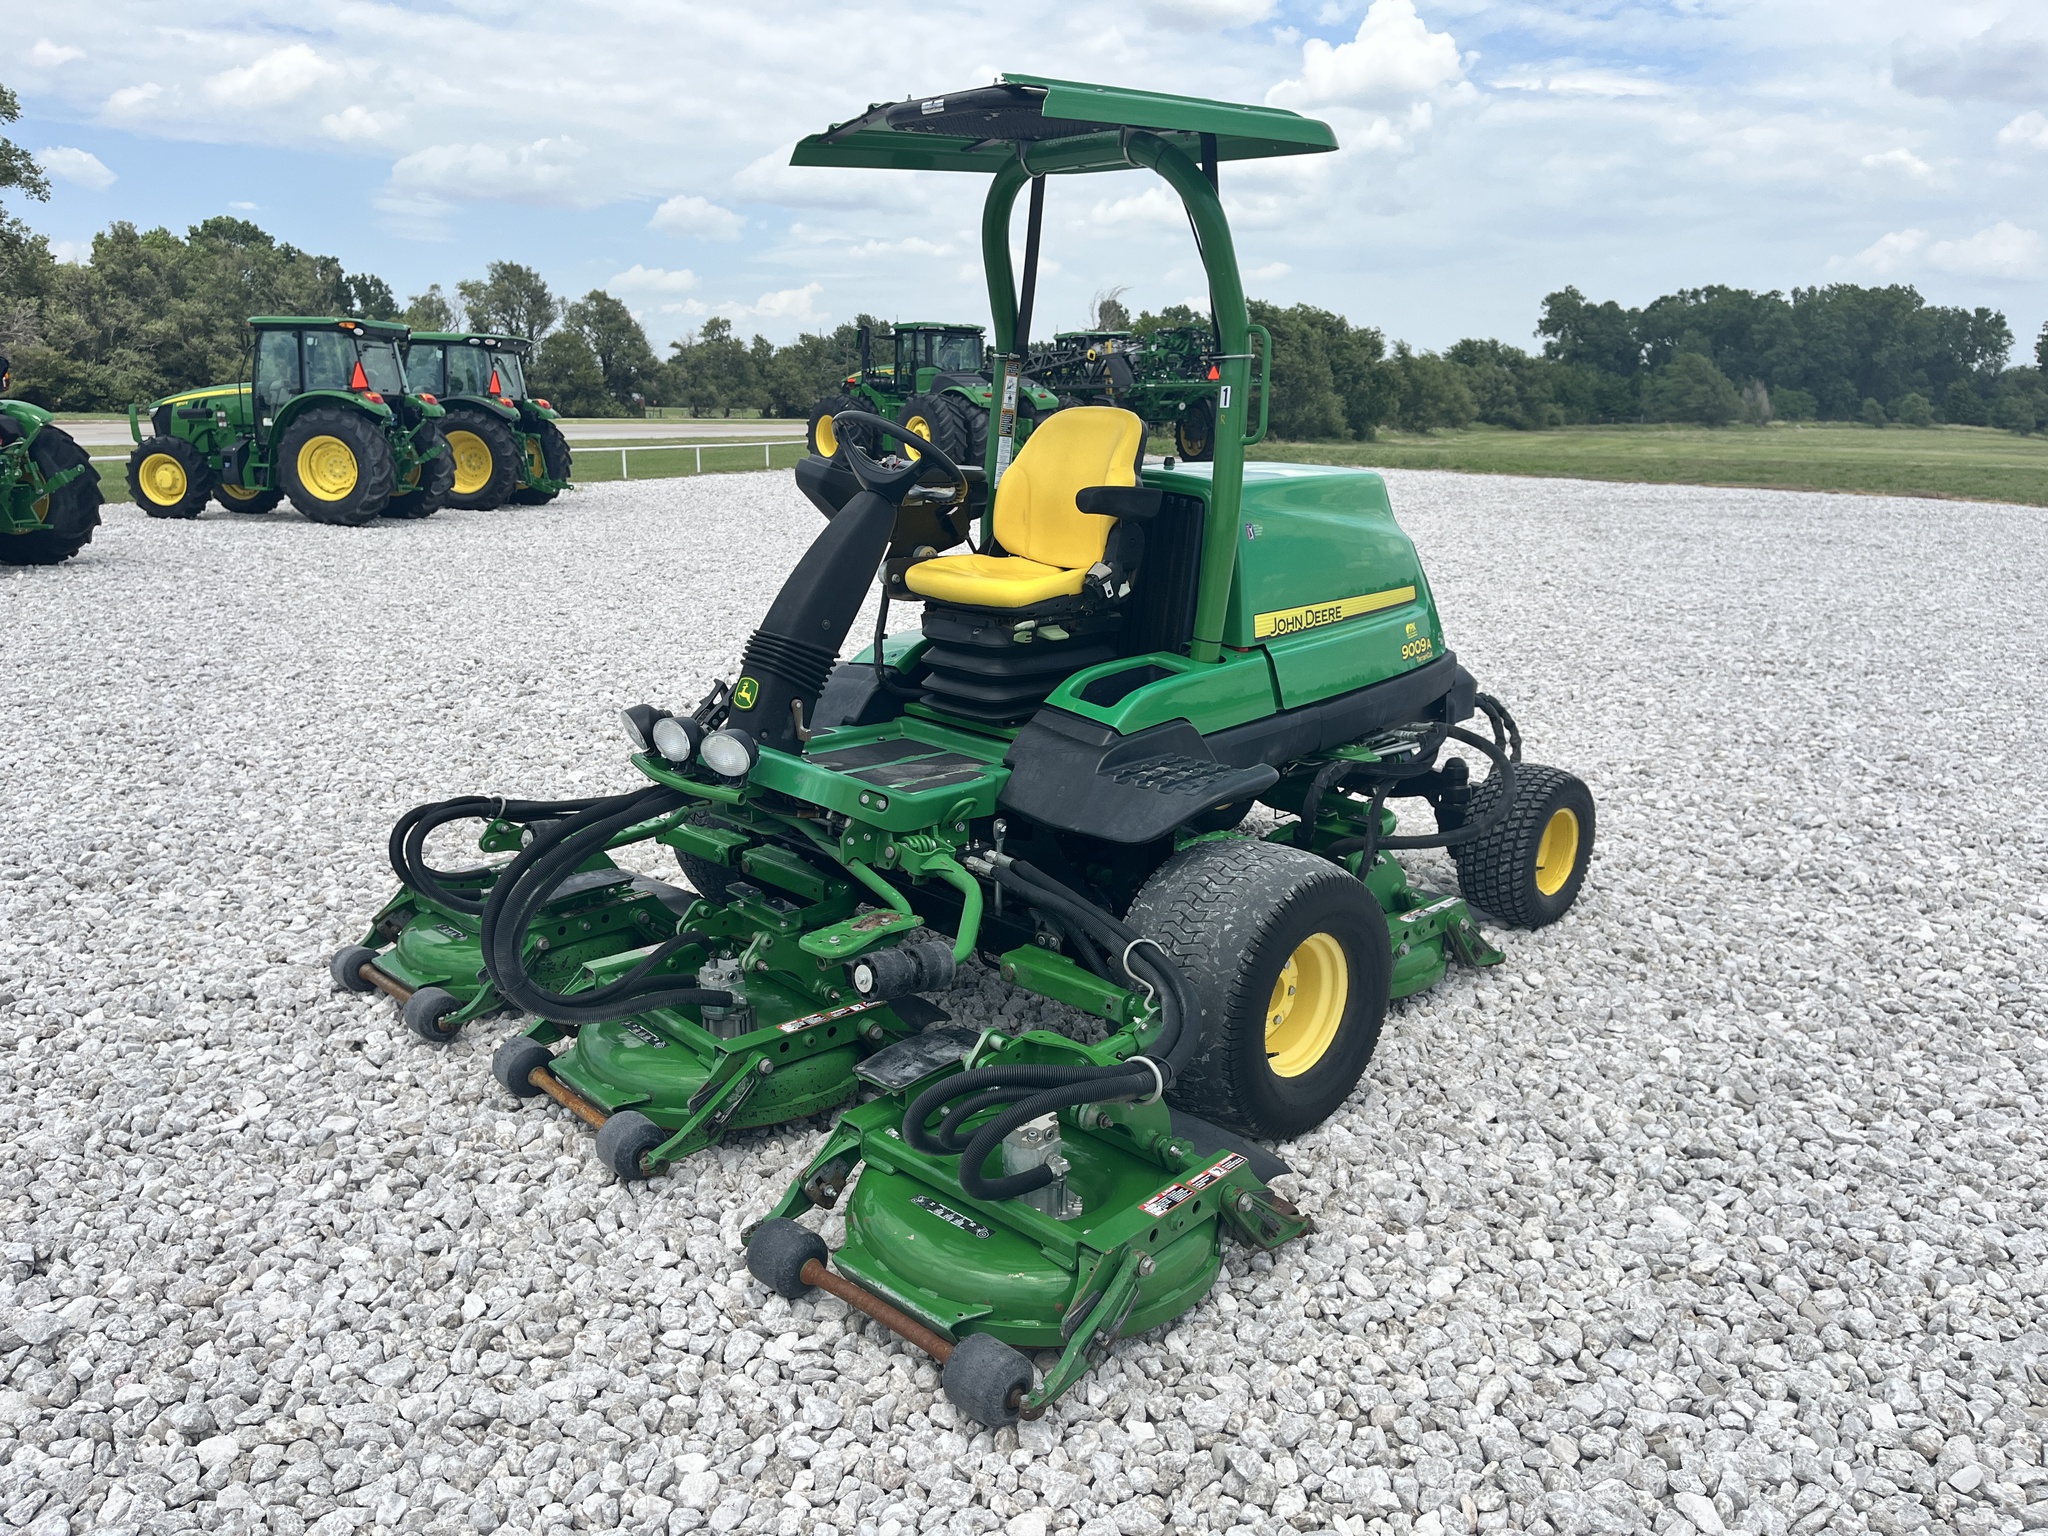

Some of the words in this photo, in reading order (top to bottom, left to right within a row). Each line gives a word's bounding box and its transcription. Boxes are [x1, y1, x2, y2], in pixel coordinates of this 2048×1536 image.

[1223, 387, 1229, 407] 1
[1270, 614, 1303, 635] JOHN
[1305, 605, 1342, 626] DEERE
[1401, 637, 1432, 660] 9009A
